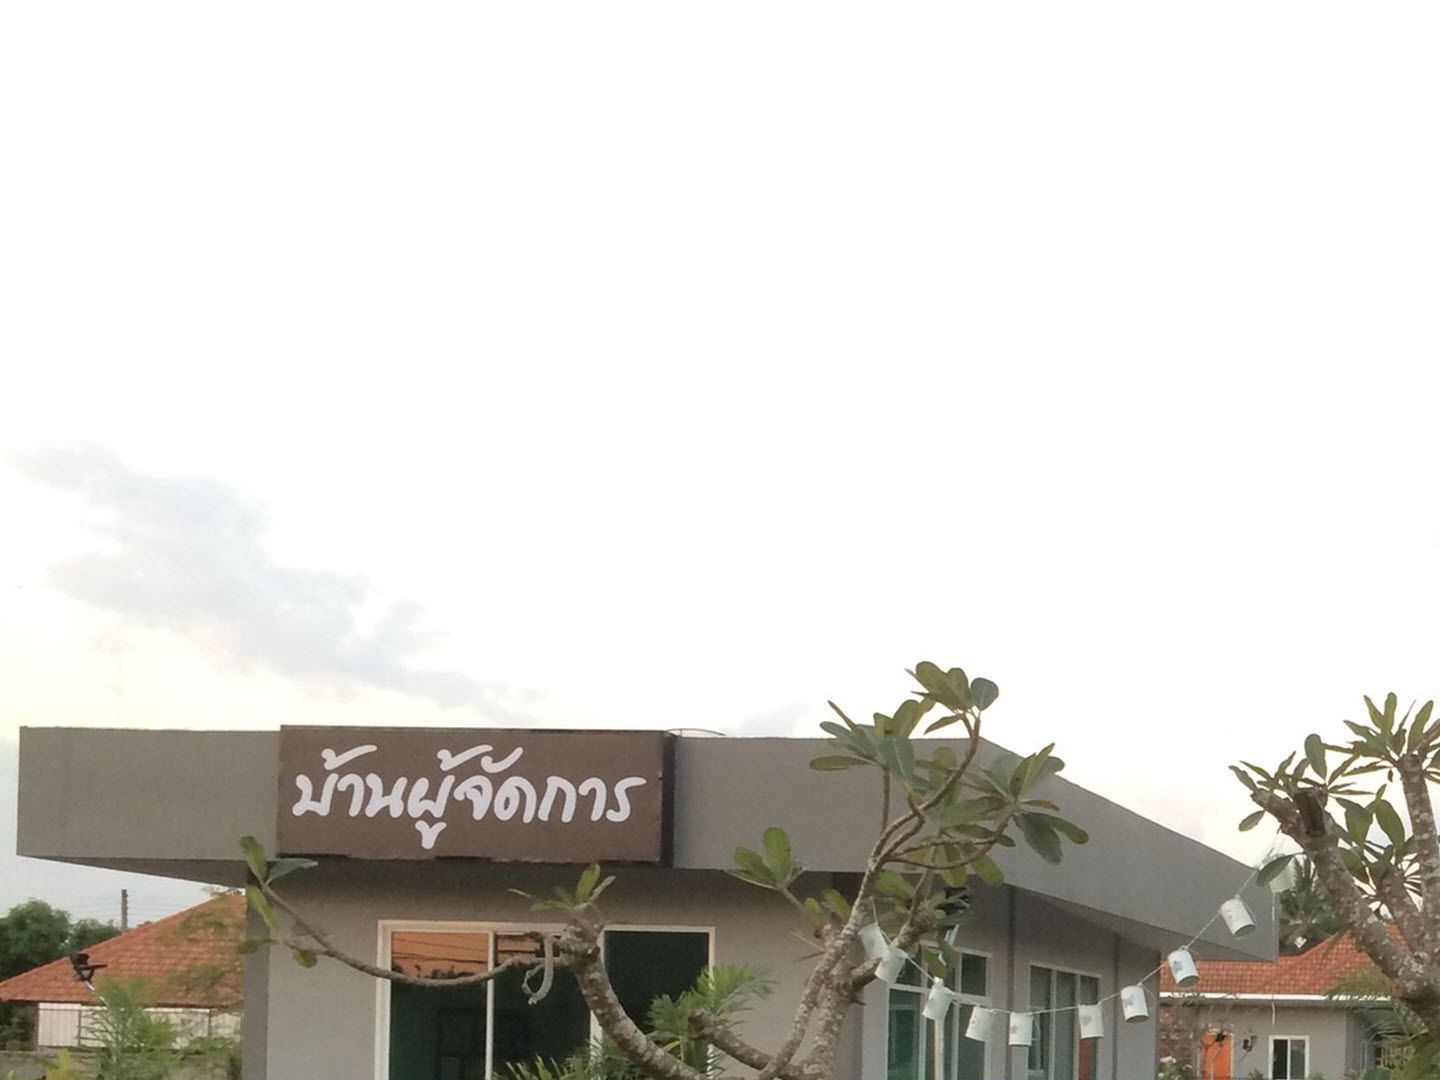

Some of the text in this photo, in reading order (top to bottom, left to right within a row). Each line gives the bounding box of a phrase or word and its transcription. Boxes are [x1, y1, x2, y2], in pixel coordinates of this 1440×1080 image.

[292, 744, 647, 850] บ้านผู้จัดการ
